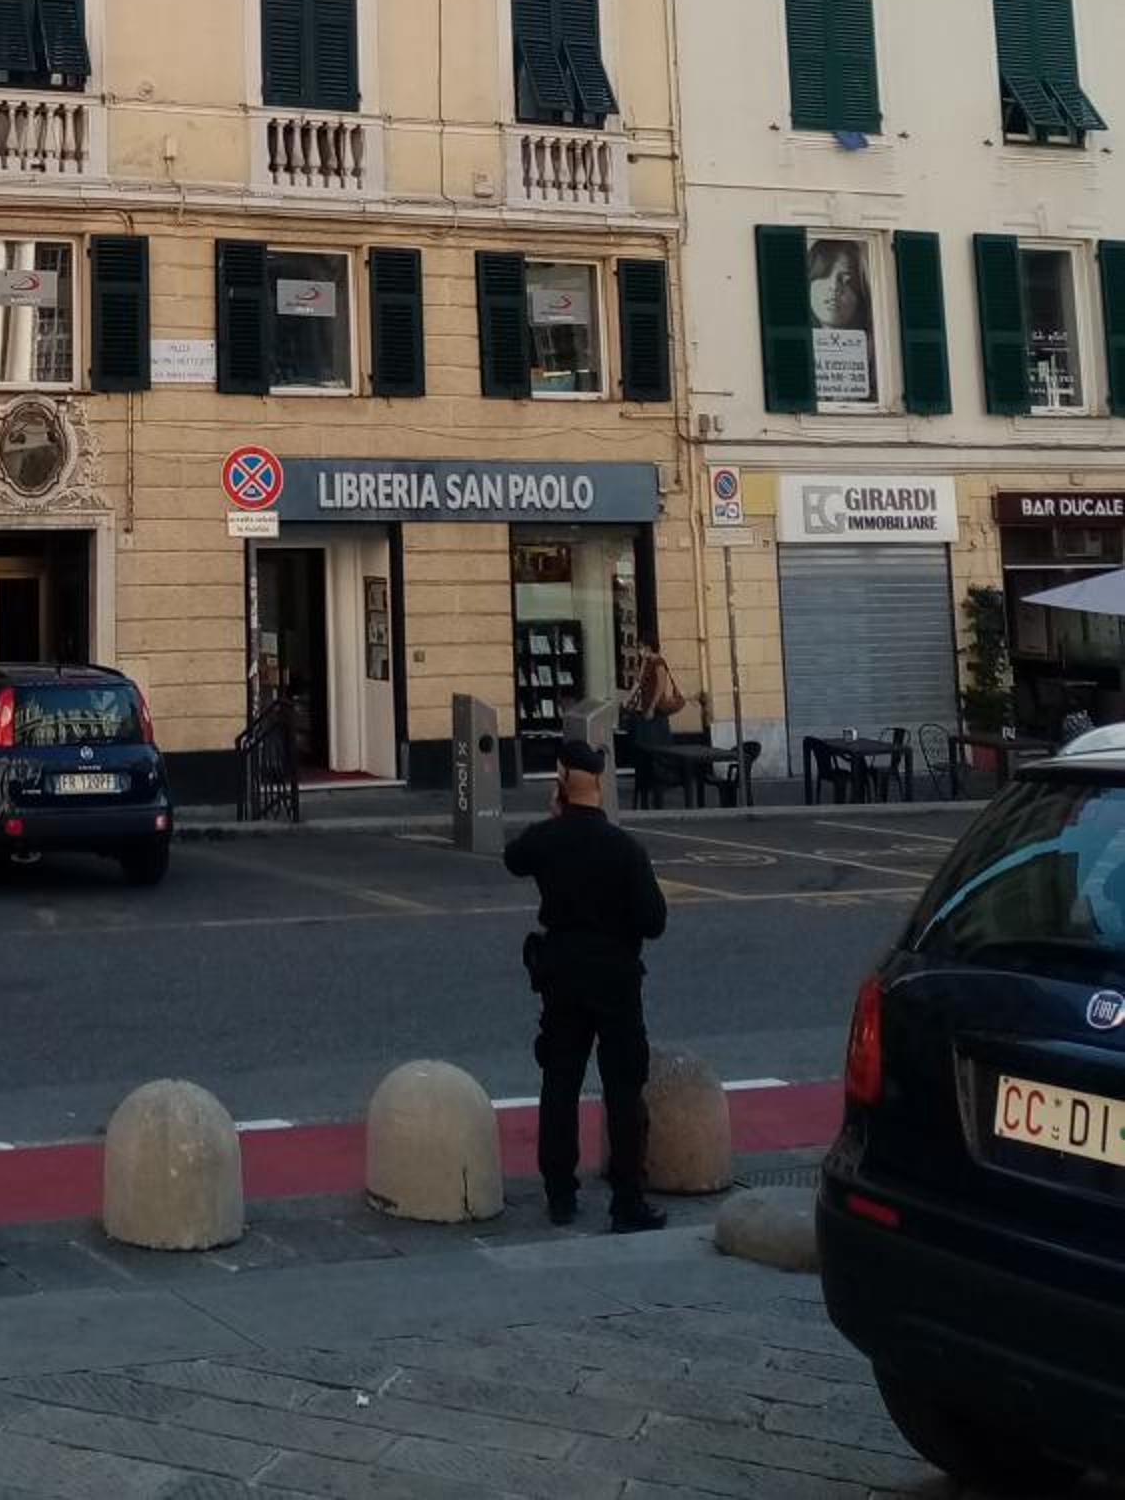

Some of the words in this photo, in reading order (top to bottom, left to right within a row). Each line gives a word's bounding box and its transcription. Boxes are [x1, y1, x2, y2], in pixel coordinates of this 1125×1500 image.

[318, 471, 441, 509] LIBRERIA
[446, 473, 504, 510] SAN
[508, 474, 594, 509] PAOLO
[844, 488, 937, 511] GIRARDI
[1021, 498, 1056, 516] BAR
[1059, 498, 1124, 516] DUCALE
[848, 515, 938, 531] IMMOBILIARE
[1003, 1085, 1045, 1136] CC
